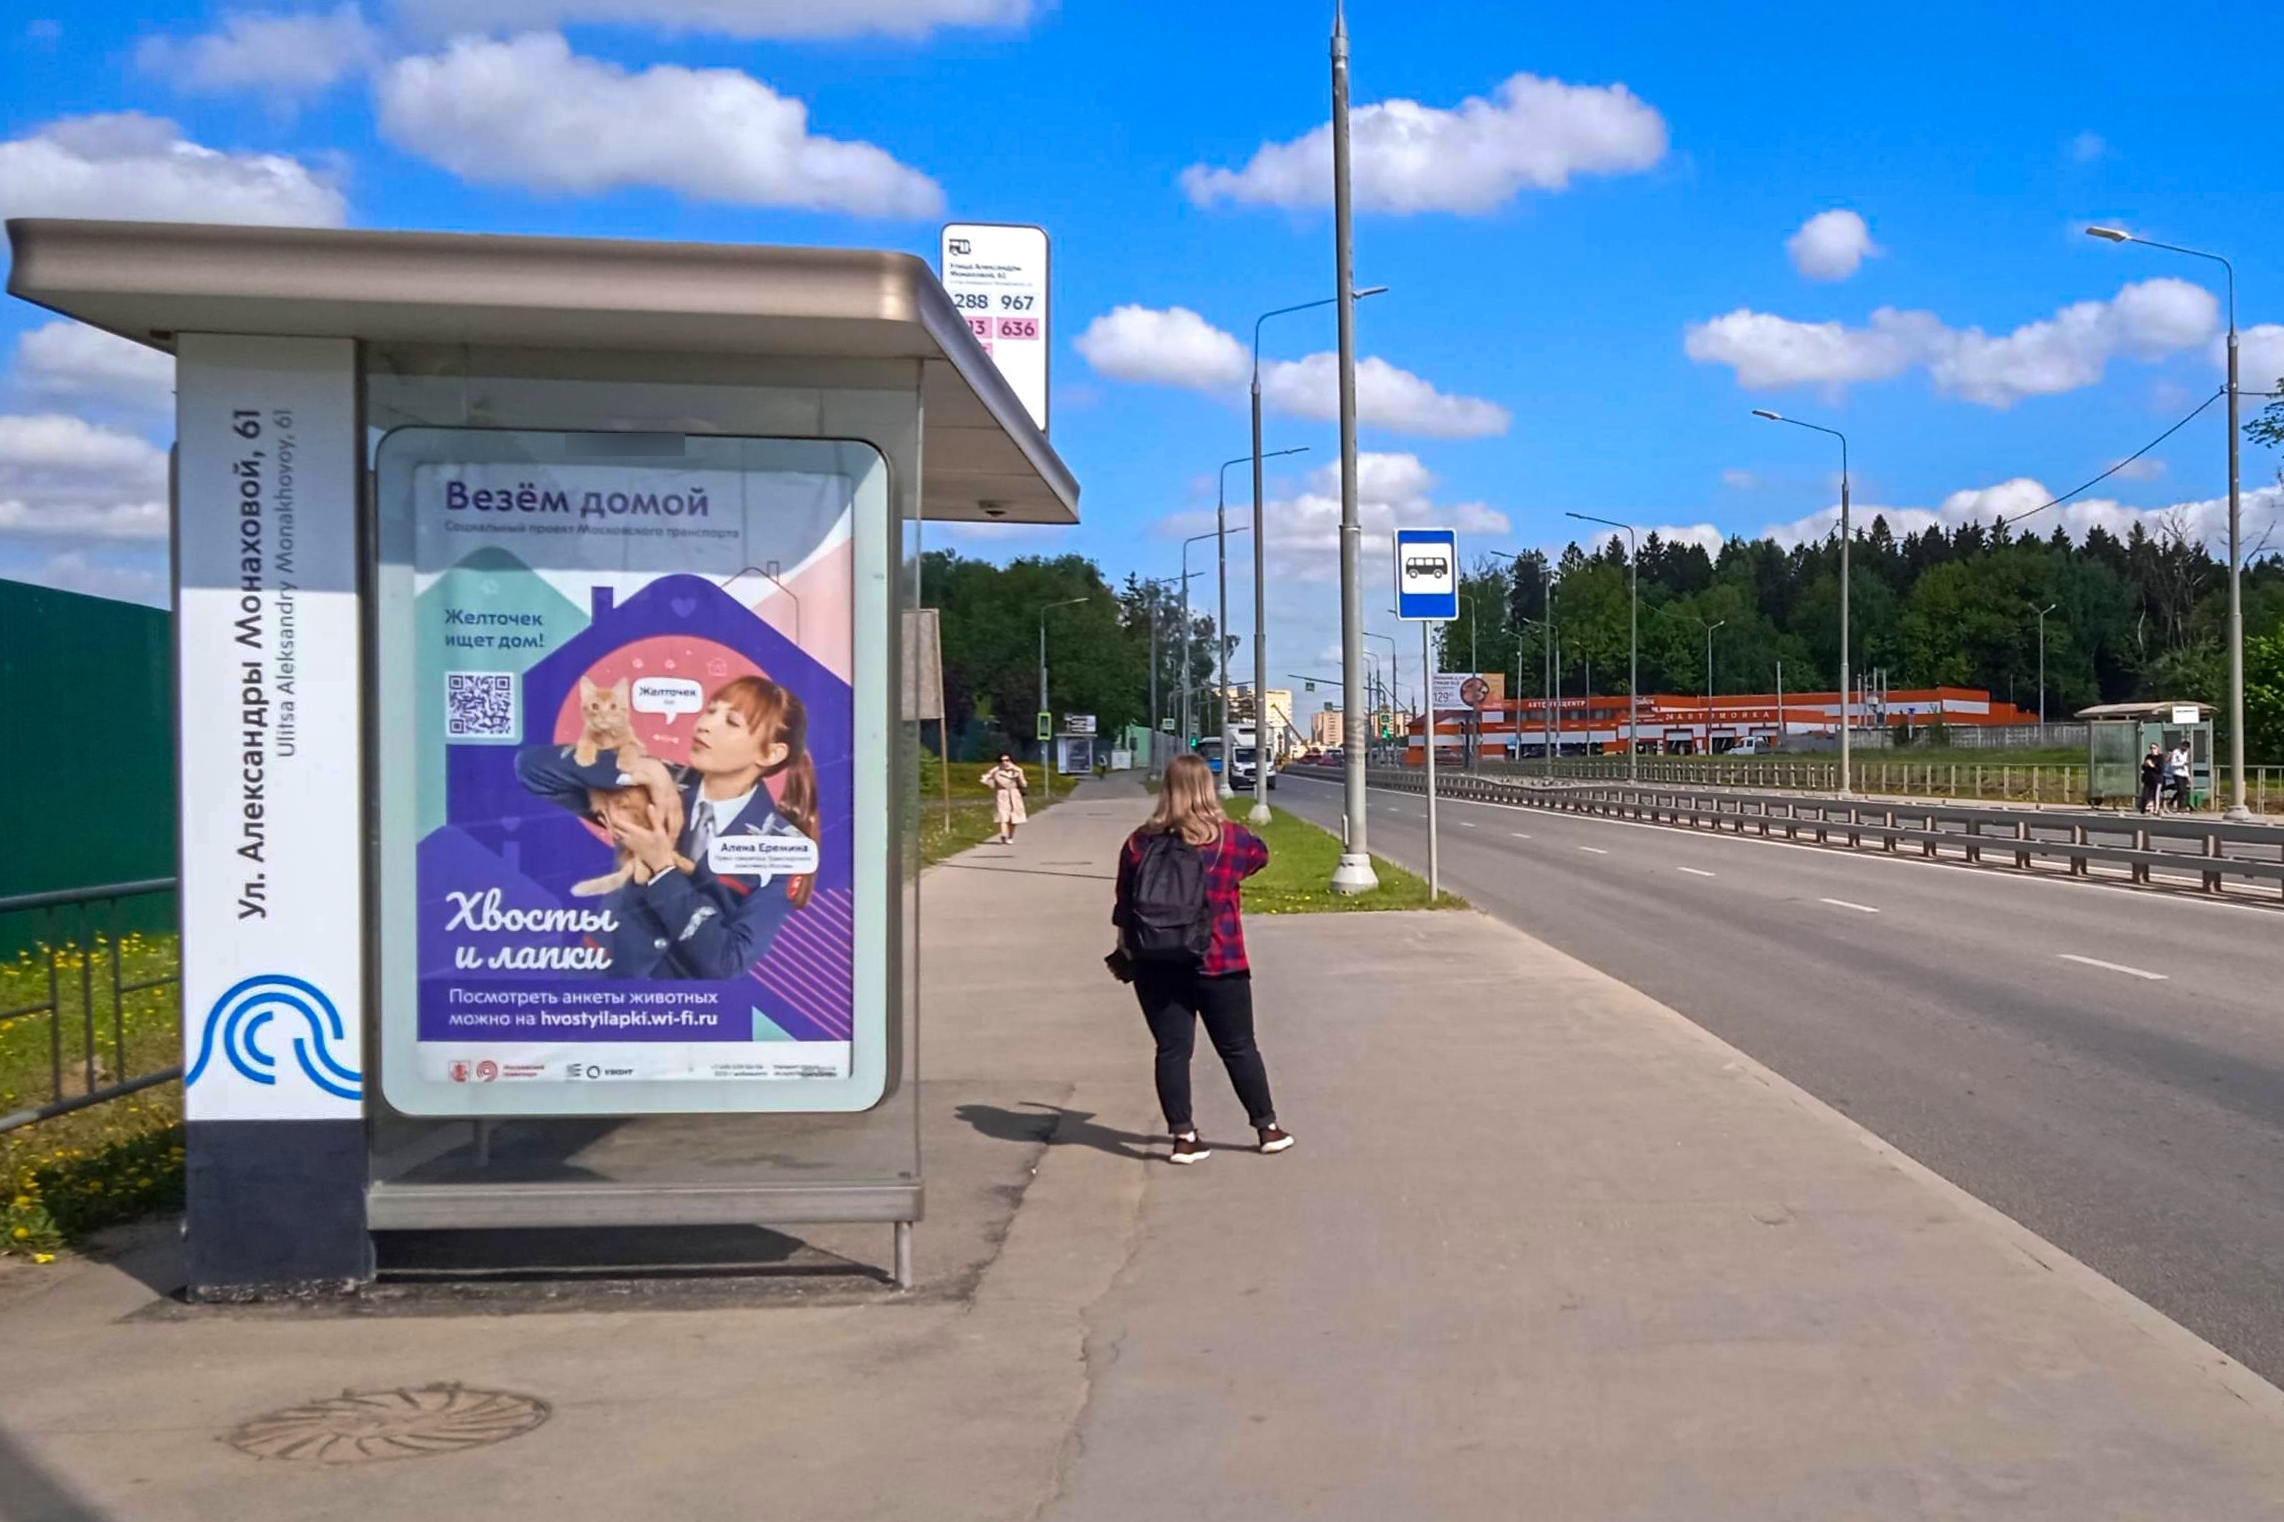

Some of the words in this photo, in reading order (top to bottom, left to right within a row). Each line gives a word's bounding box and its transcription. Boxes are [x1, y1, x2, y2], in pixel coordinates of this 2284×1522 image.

[954, 293, 988, 309] 288
[1001, 295, 1034, 310] 967
[968, 320, 986, 335] 13
[1001, 321, 1035, 336] 636
[232, 409, 261, 440] 61
[272, 409, 293, 429] 61
[273, 435, 296, 574] Monakhovoy,
[445, 481, 570, 513] Везём
[580, 487, 710, 519] домой
[232, 451, 266, 649] Монаховой,
[444, 609, 543, 626] Желточек
[275, 580, 298, 695] Aleksandry
[445, 635, 495, 648] ищет
[498, 633, 544, 650] дом!
[275, 701, 296, 757] Ulitsa
[237, 661, 269, 863] Александры
[238, 873, 266, 920] Ул.
[445, 887, 620, 932] Хвосты
[455, 946, 483, 970] и
[487, 946, 613, 970] лапки
[449, 988, 558, 1008] Посмотреть
[562, 992, 624, 1004] анкеты
[629, 992, 719, 1004] животных
[449, 1014, 511, 1026] можно
[515, 1014, 536, 1026] на
[541, 1010, 718, 1029] hvostyilapki.wi-fi.ru
